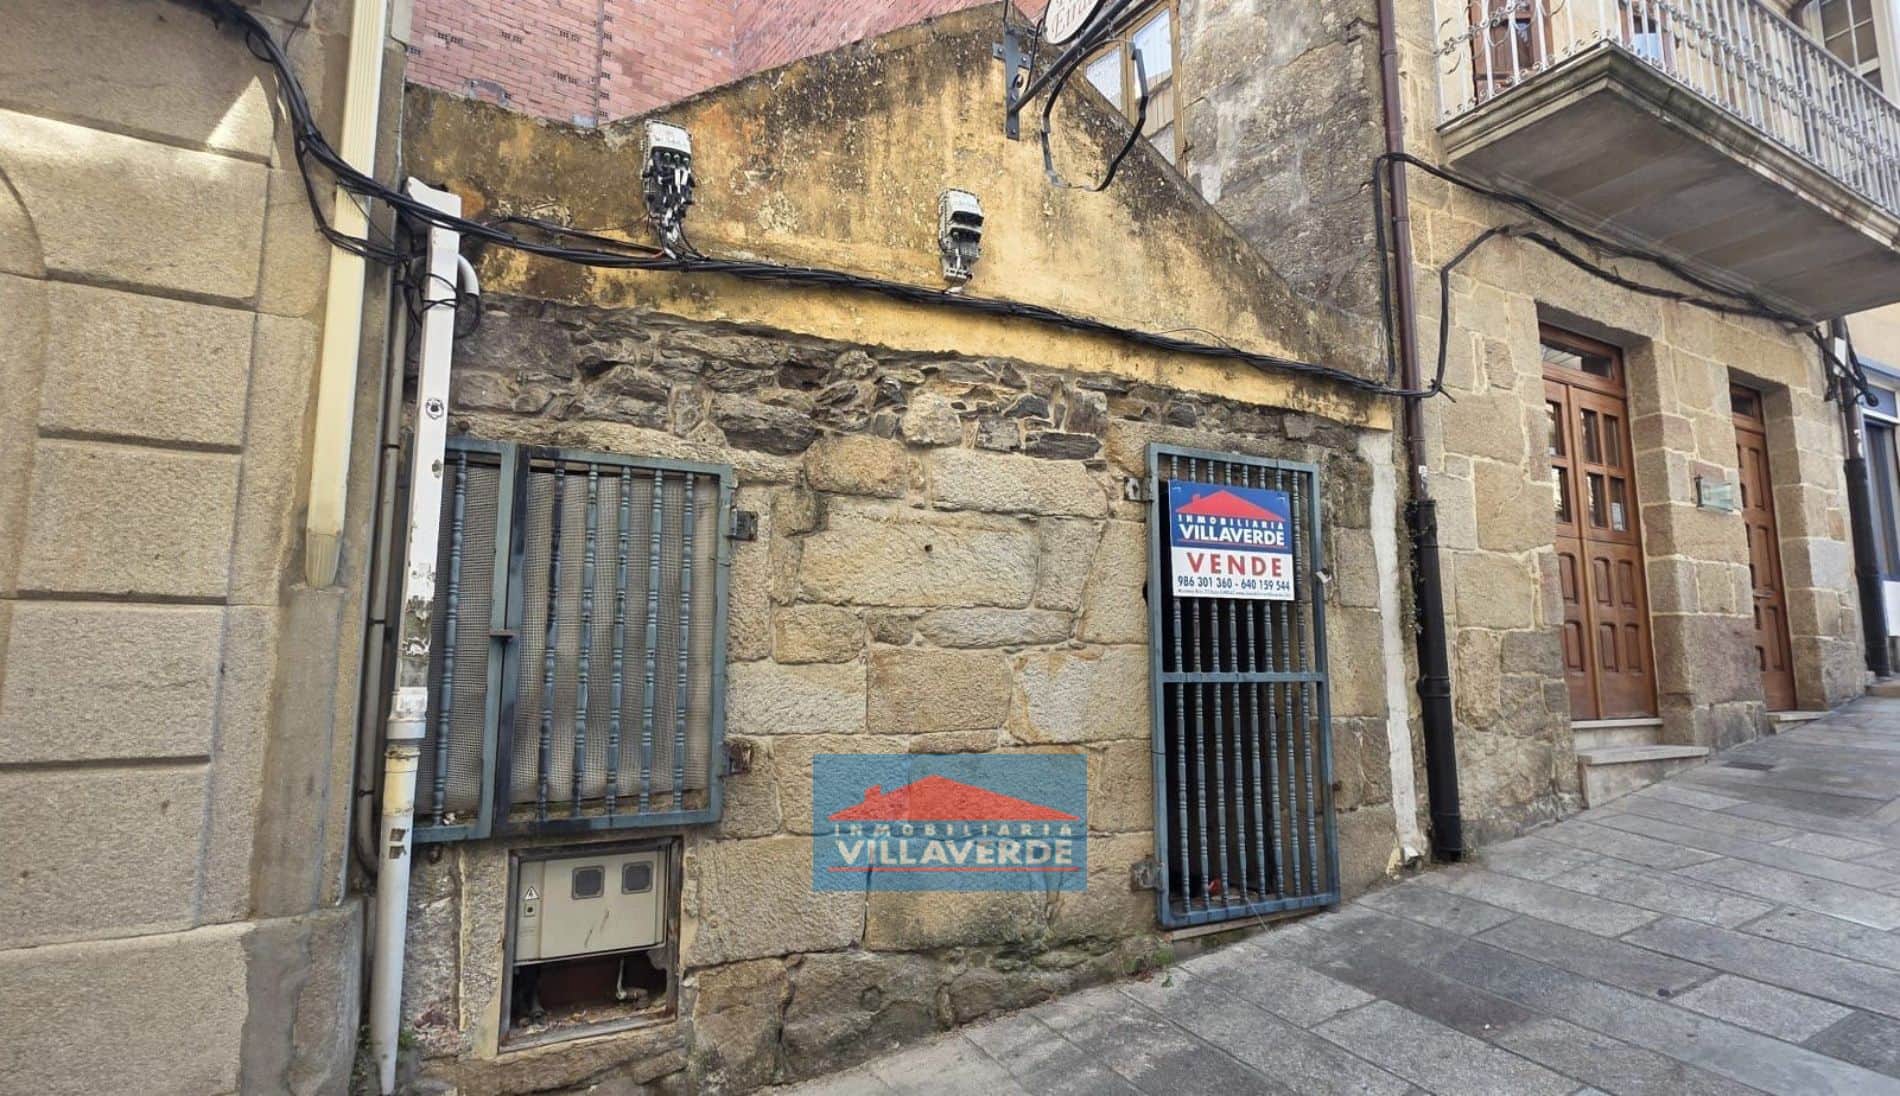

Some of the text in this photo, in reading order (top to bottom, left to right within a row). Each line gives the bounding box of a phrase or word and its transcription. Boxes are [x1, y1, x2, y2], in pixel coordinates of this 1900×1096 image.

[1178, 514, 1284, 530] INMOBILIARIA
[1179, 523, 1285, 546] VILLAVERDE
[1187, 552, 1282, 577] VENDE
[1178, 576, 1194, 587] 986
[1198, 577, 1212, 587] 301
[1216, 578, 1232, 589] 360
[1241, 579, 1256, 590] 640
[1260, 580, 1273, 591] 159
[1276, 580, 1290, 591] 544
